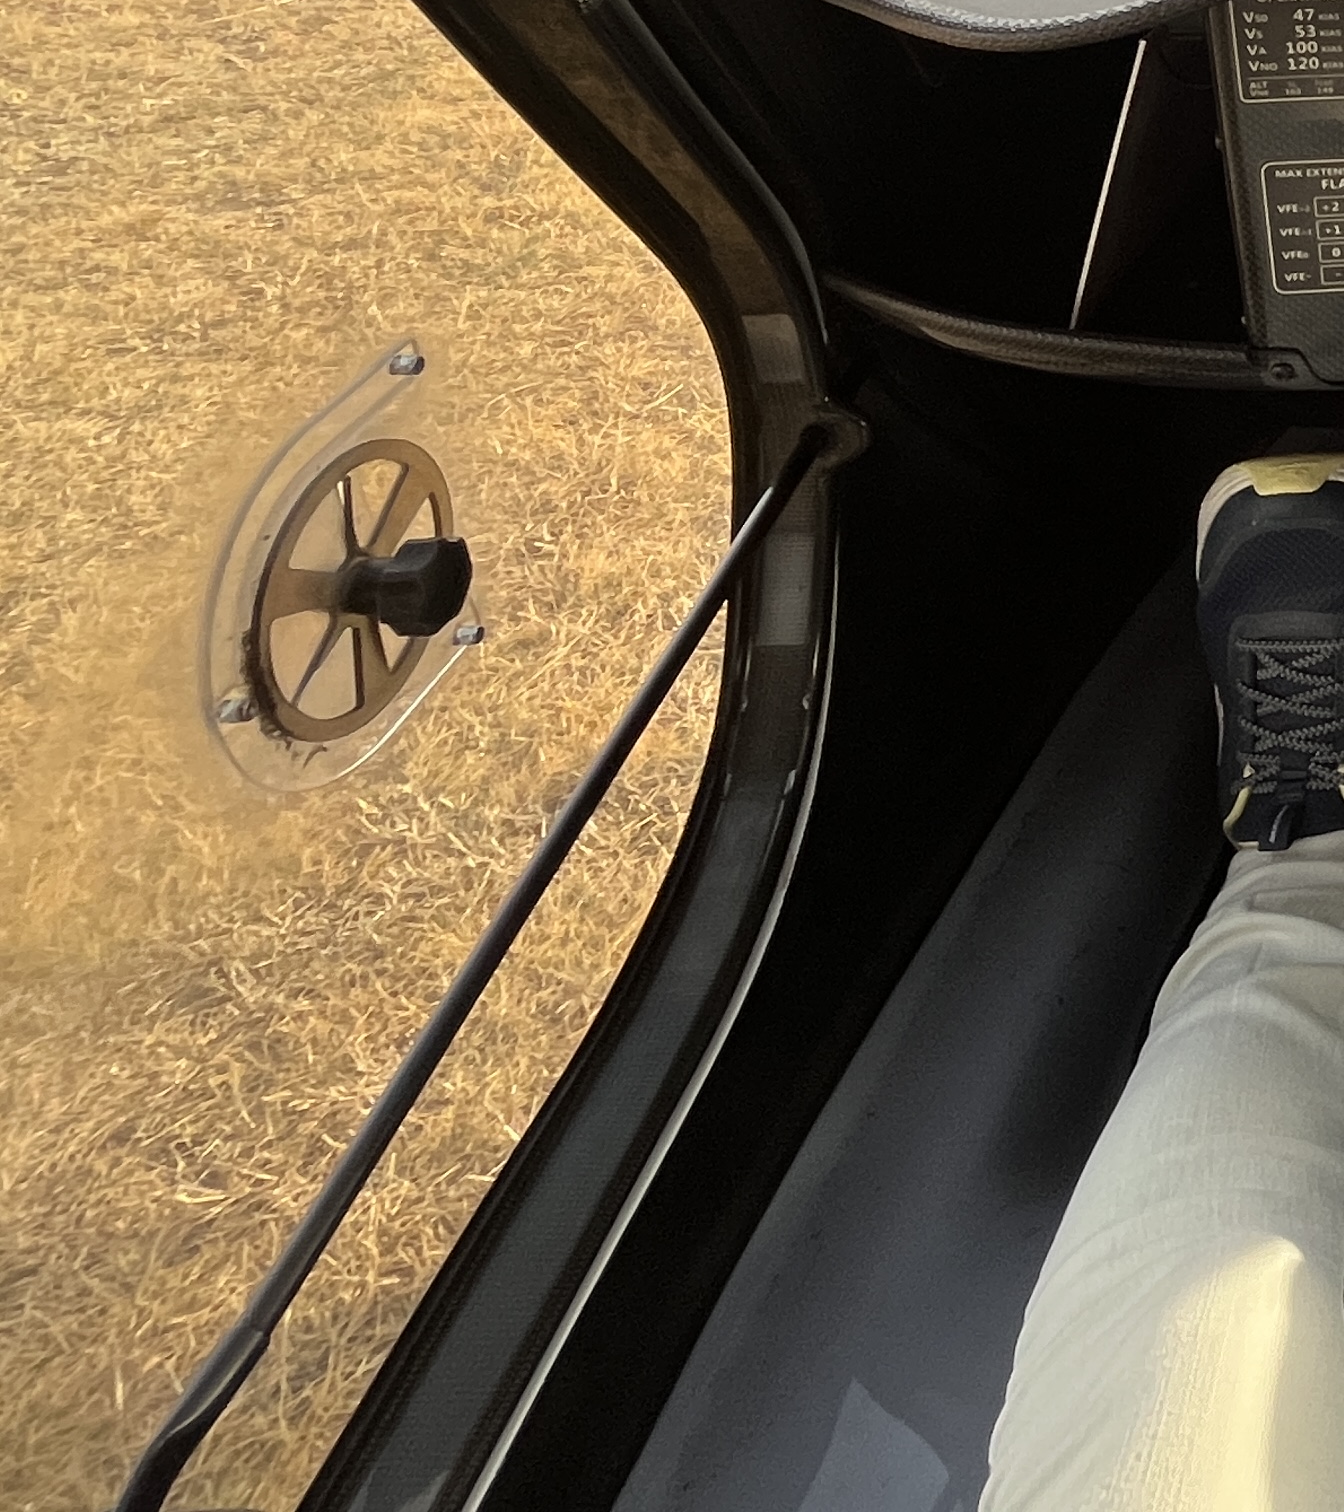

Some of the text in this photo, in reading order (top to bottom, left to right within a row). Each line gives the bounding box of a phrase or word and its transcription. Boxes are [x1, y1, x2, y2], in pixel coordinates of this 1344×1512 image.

[1293, 8, 1315, 22] 47
[1294, 24, 1317, 38] 53
[1286, 41, 1318, 55] 100
[1288, 57, 1320, 71] 120
[1250, 80, 1267, 89] ALT
[1275, 169, 1303, 178] MAX
